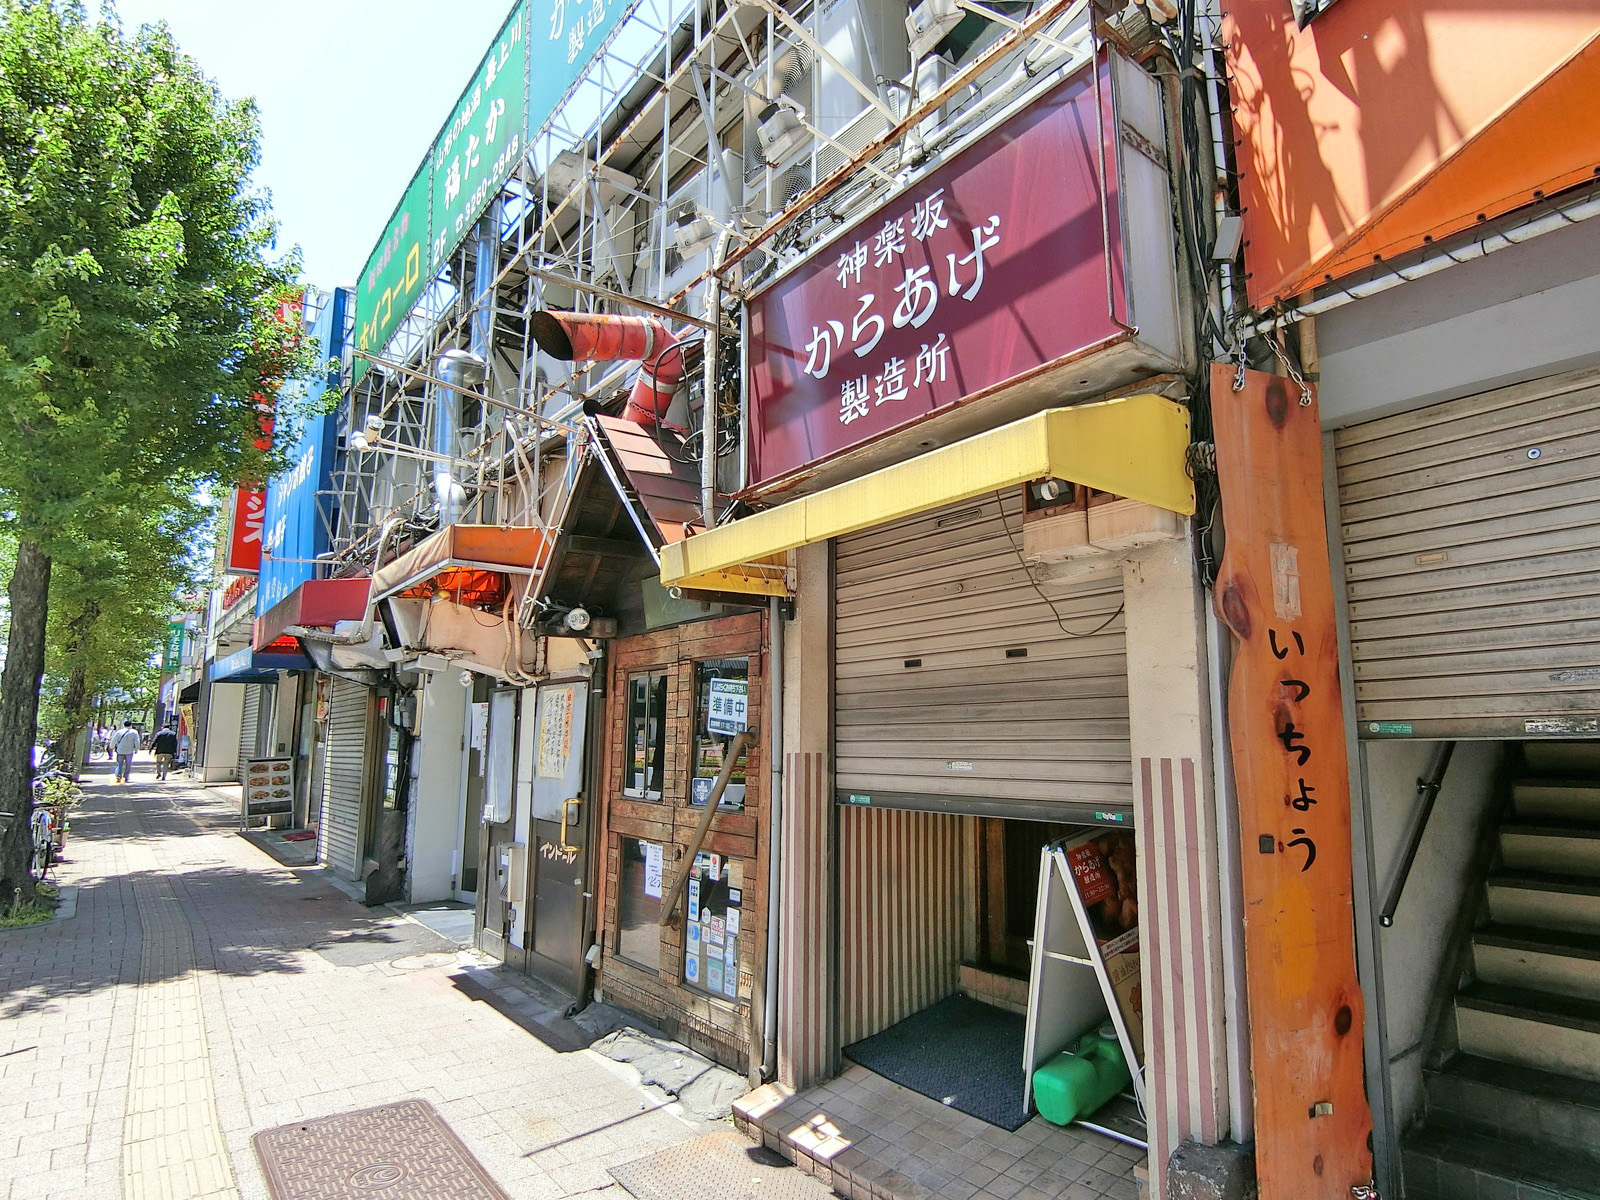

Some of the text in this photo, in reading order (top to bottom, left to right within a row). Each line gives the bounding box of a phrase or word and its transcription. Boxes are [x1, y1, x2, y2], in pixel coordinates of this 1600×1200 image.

[567, 0, 613, 65] 製造
[433, 227, 448, 266] 2F
[836, 187, 949, 289] 神楽坂
[803, 215, 1001, 379] からあげ
[839, 333, 950, 425] 製造所
[712, 696, 745, 718] 準備中
[1268, 629, 1317, 873] いっちょう
[1073, 855, 1101, 876] からあげ
